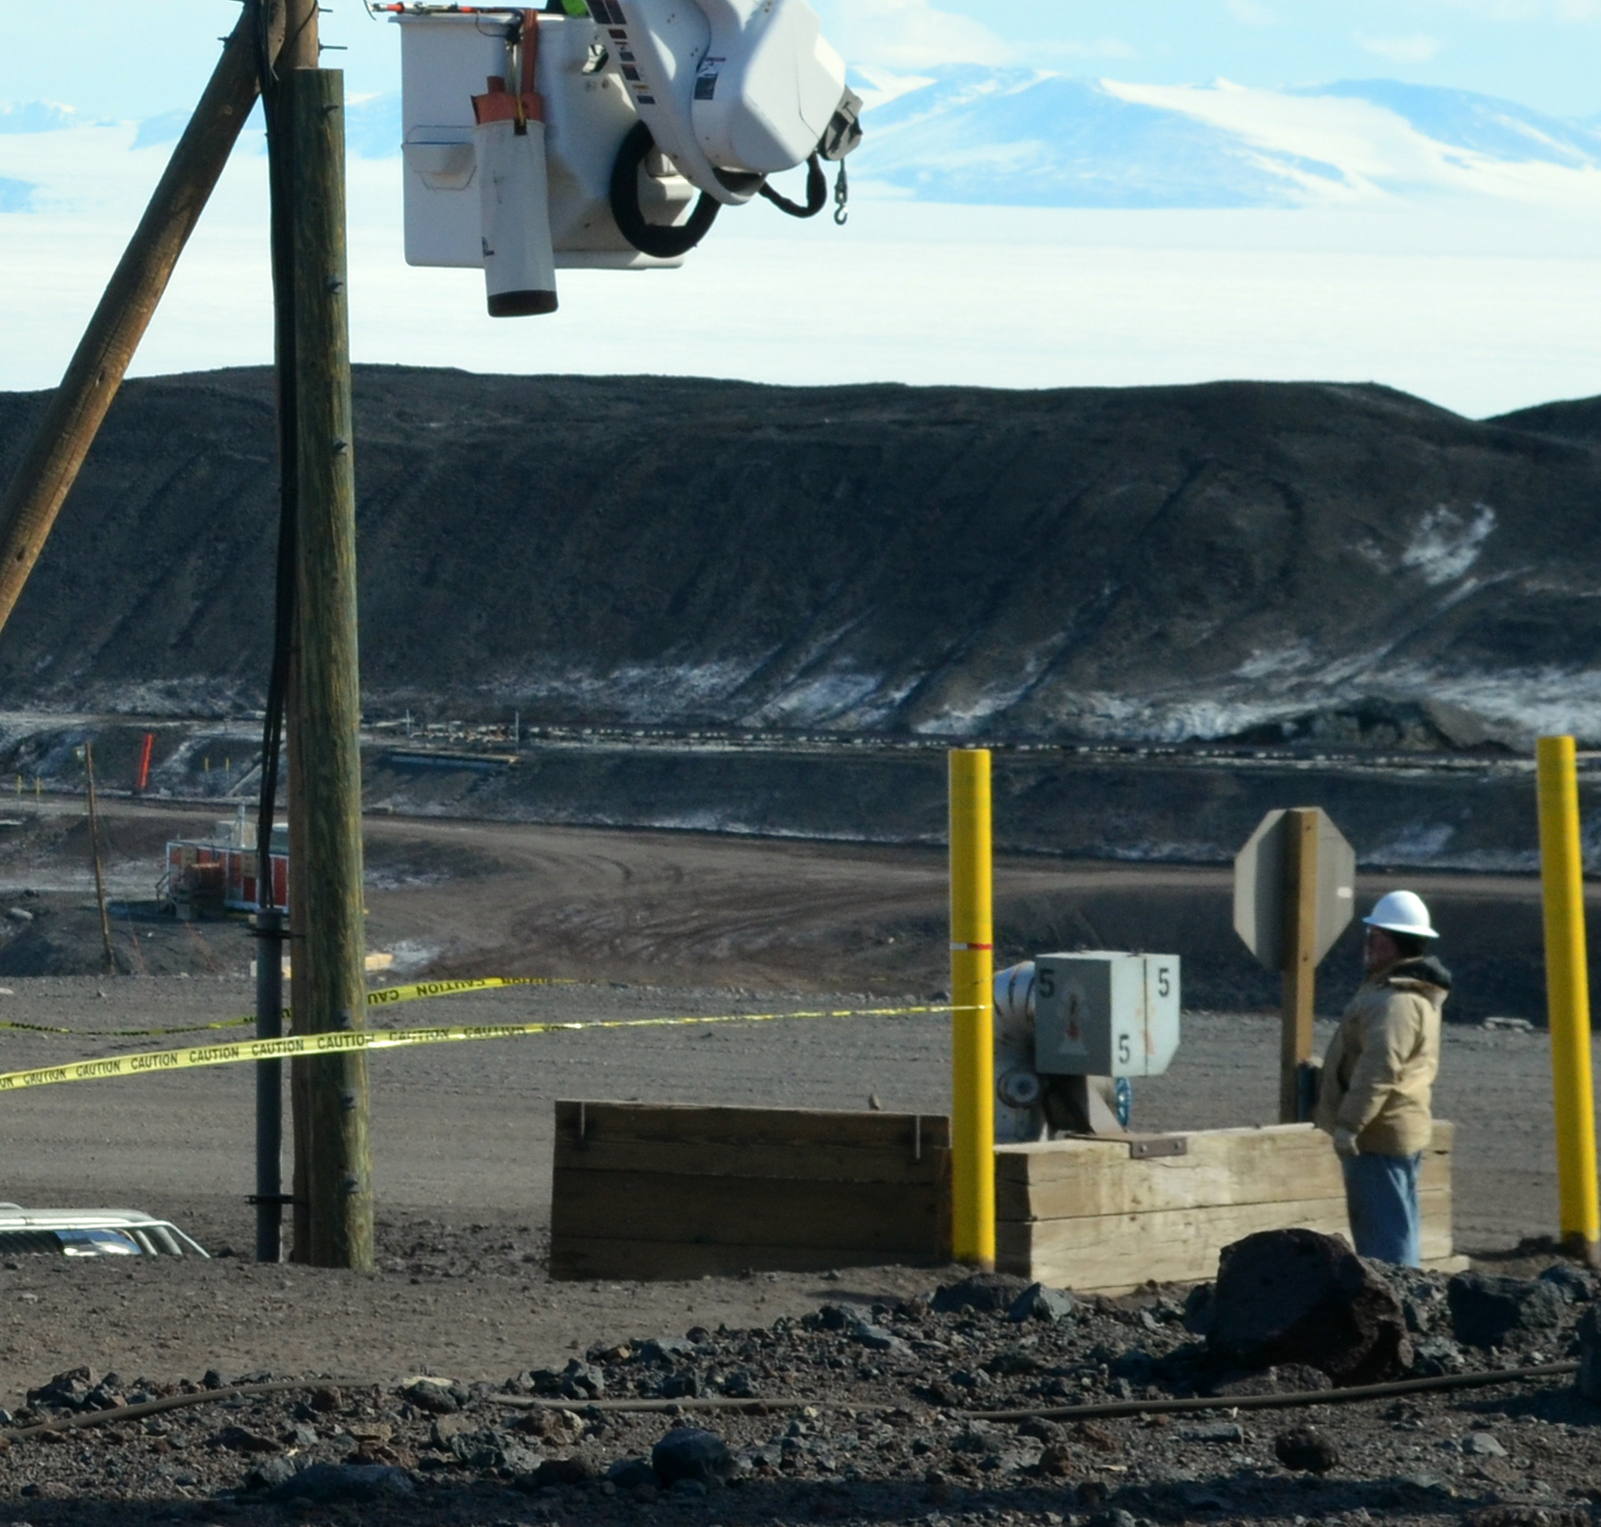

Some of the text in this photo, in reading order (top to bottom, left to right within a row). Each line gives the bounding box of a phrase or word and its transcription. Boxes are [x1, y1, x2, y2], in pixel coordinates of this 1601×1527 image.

[1038, 967, 1056, 999] 5
[1158, 967, 1170, 998] 5
[23, 1068, 67, 1085] CAUTION
[75, 1059, 121, 1078] CAUTION
[130, 1053, 178, 1071] CAUTION
[189, 1046, 240, 1063] CAUTION
[251, 1039, 305, 1057] CAUTION
[1118, 1034, 1131, 1065] 5
